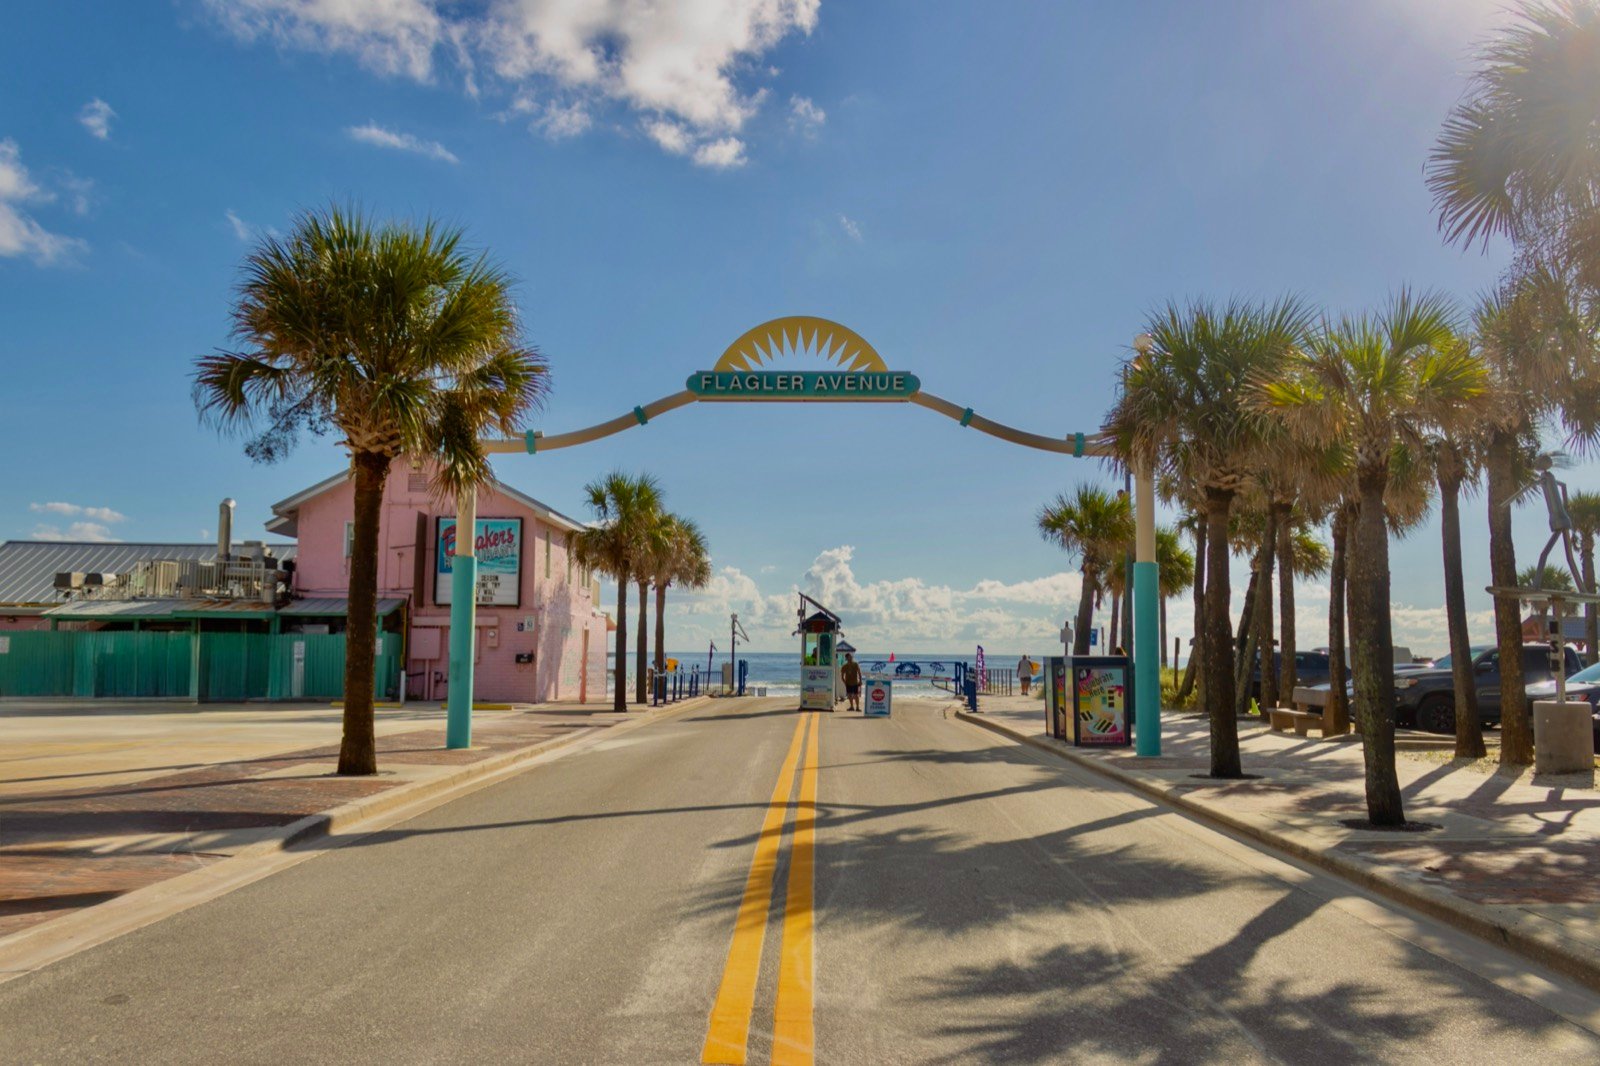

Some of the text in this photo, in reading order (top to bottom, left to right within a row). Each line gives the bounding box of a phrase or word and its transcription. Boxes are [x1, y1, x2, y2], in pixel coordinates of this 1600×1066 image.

[701, 375, 906, 390] FLAGLER AVENUE
[442, 524, 514, 557] Bakers
